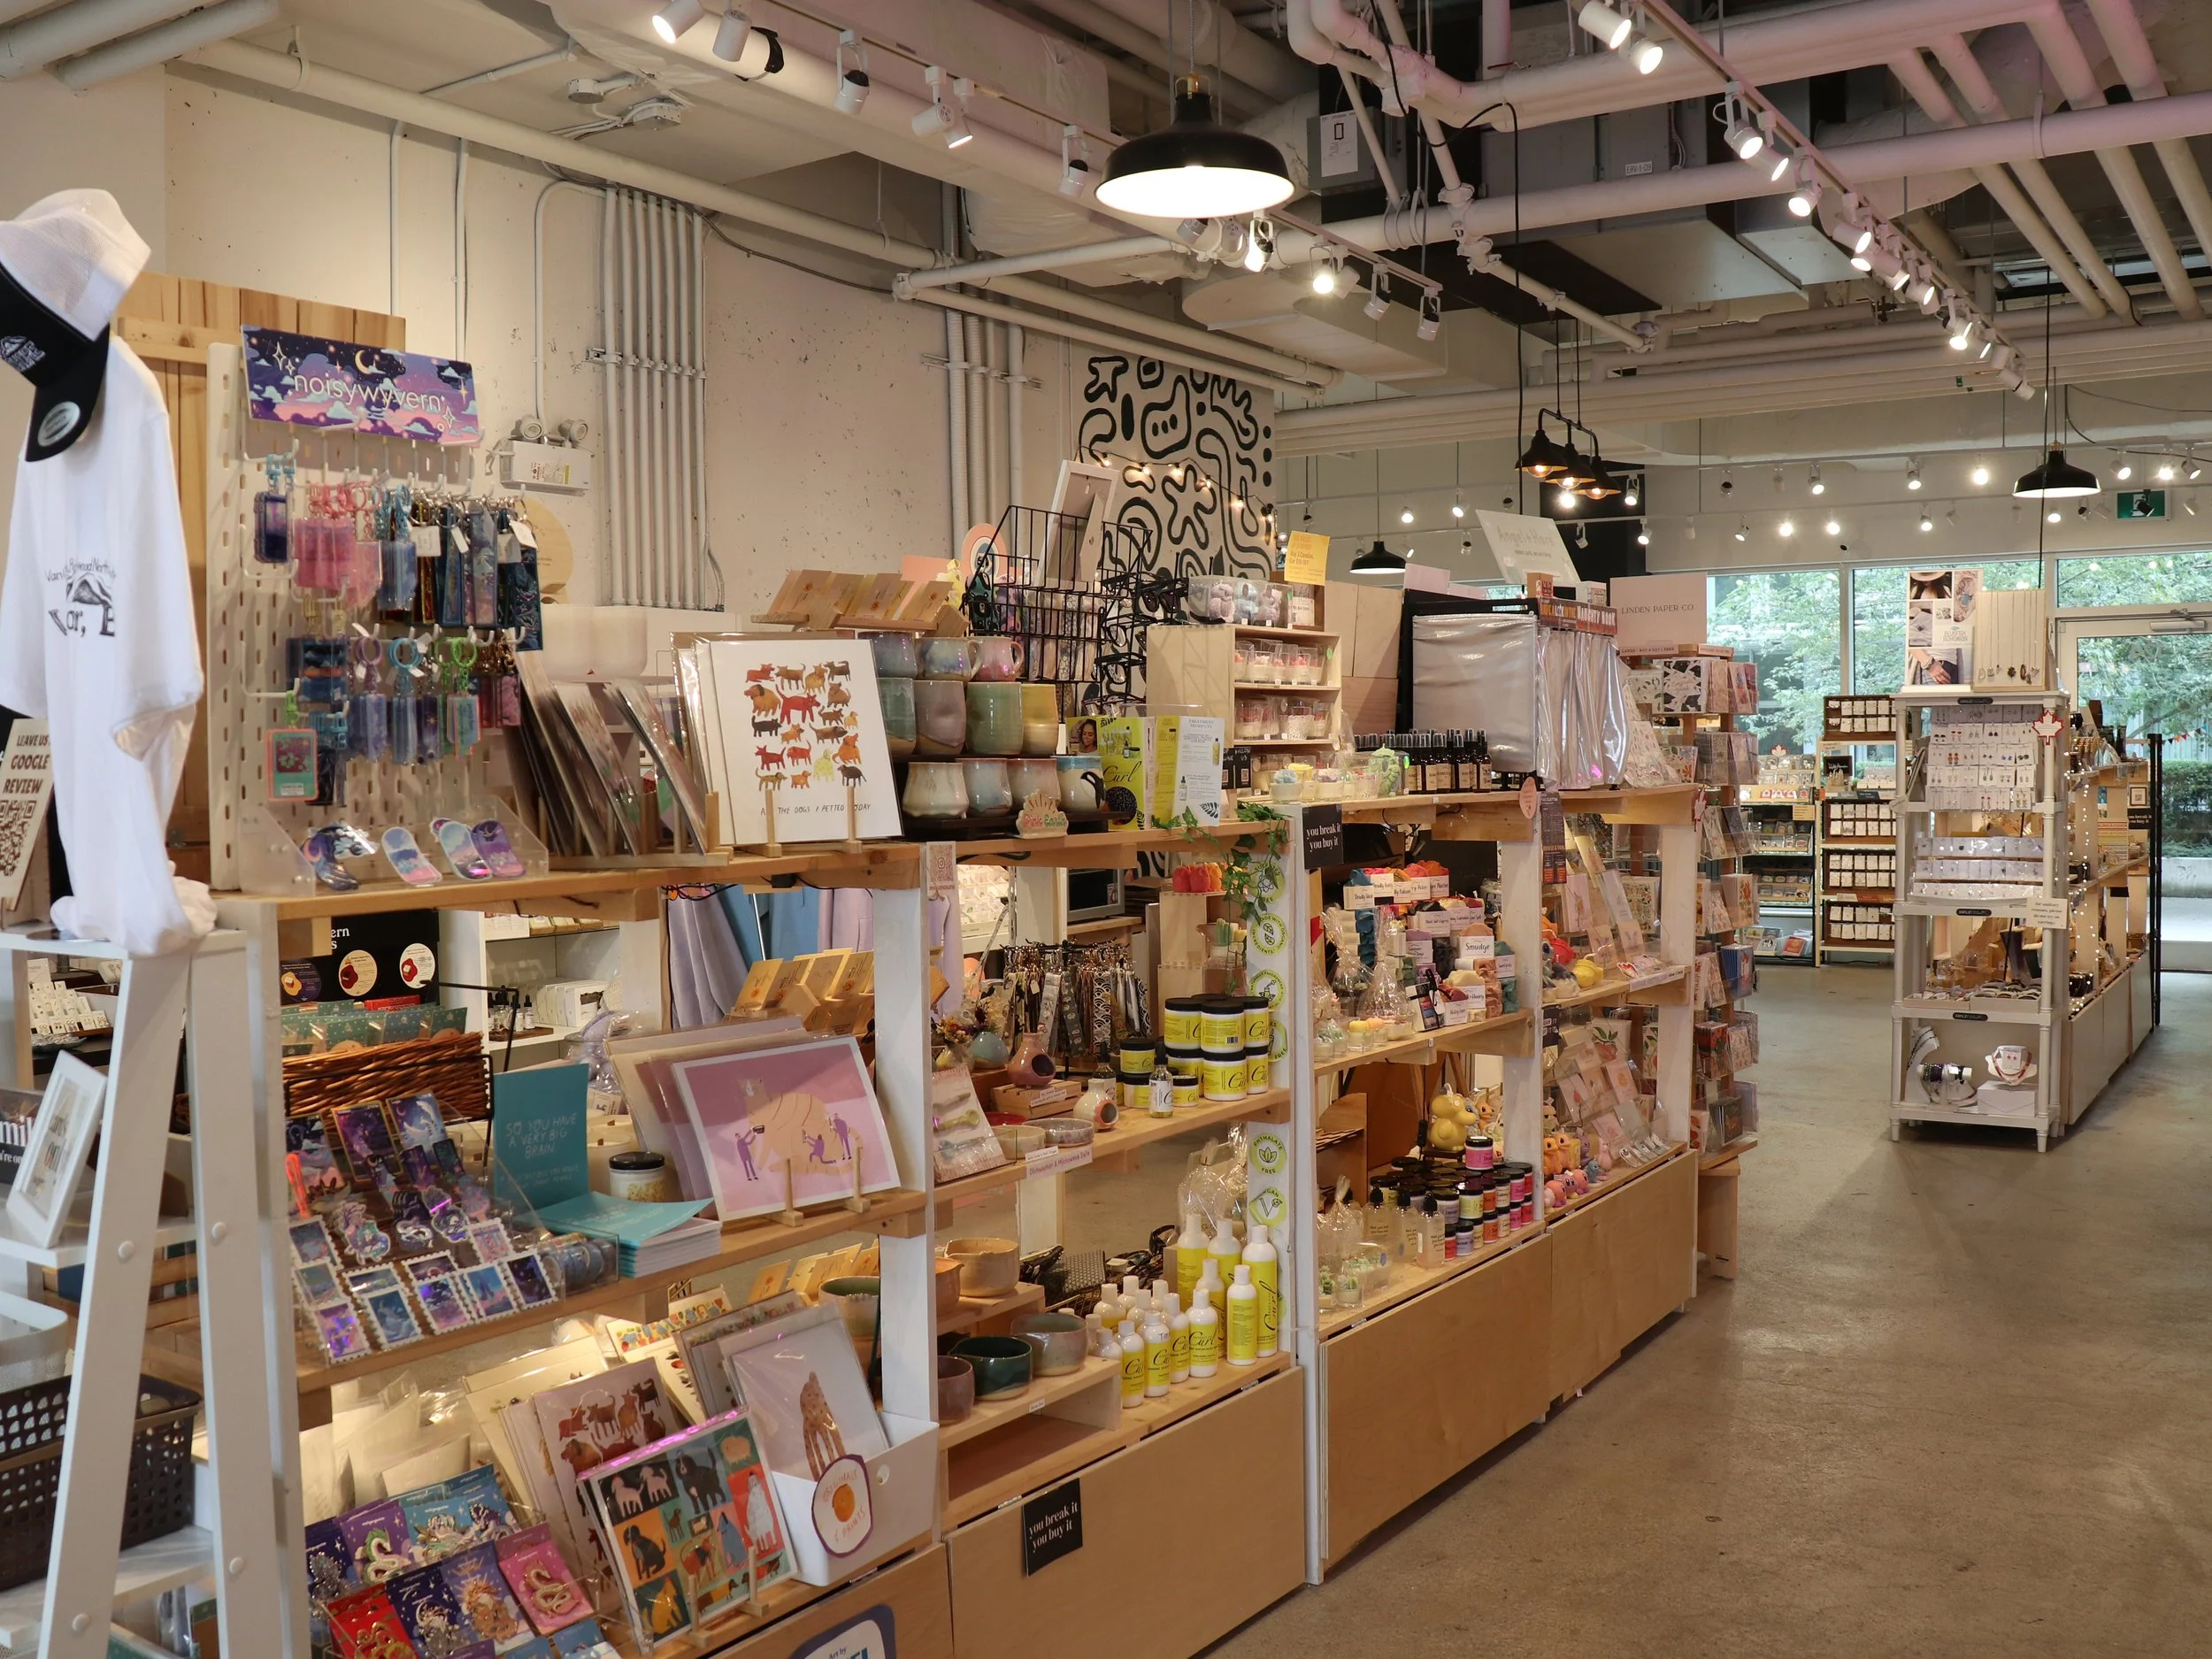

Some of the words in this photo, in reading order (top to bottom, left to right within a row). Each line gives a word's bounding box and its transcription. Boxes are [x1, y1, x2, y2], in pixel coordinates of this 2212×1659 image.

[294, 374, 442, 412] noisywyvern
[16, 734, 38, 746] LEAVE
[39, 734, 49, 745] US
[11, 755, 50, 770] GOOGLE
[1102, 761, 1142, 783] Curl
[3, 779, 43, 795] REVIEW
[1307, 827, 1318, 840] you
[1319, 824, 1337, 835] break
[1337, 823, 1341, 833] it
[1310, 841, 1322, 853] you
[1323, 838, 1333, 849] buy
[1334, 836, 1339, 846] it
[1465, 942, 1490, 953] Smudge
[1248, 1020, 1269, 1038] Cur
[1274, 1047, 1286, 1060] FREE
[506, 1121, 522, 1137] SO
[528, 1118, 549, 1132] YOU
[552, 1112, 577, 1126] HAVE
[508, 1136, 517, 1148] A
[521, 1131, 547, 1146] VERY
[549, 1127, 566, 1141] BIG
[1254, 1135, 1283, 1150] PHTHALATE
[526, 1142, 555, 1159] BRAIN
[1029, 1162, 1054, 1176] Dishwasher
[1058, 1153, 1079, 1165] Microwave
[1080, 1150, 1090, 1159] Safe
[1188, 1324, 1218, 1347] Curl
[842, 1506, 865, 1538] PRINTS
[1029, 1520, 1044, 1540] you
[1045, 1505, 1070, 1527] break
[1071, 1502, 1078, 1514] it
[1033, 1533, 1048, 1553] you
[1048, 1524, 1064, 1540] buy
[1066, 1519, 1072, 1532] it
[839, 1647, 847, 1655] by
